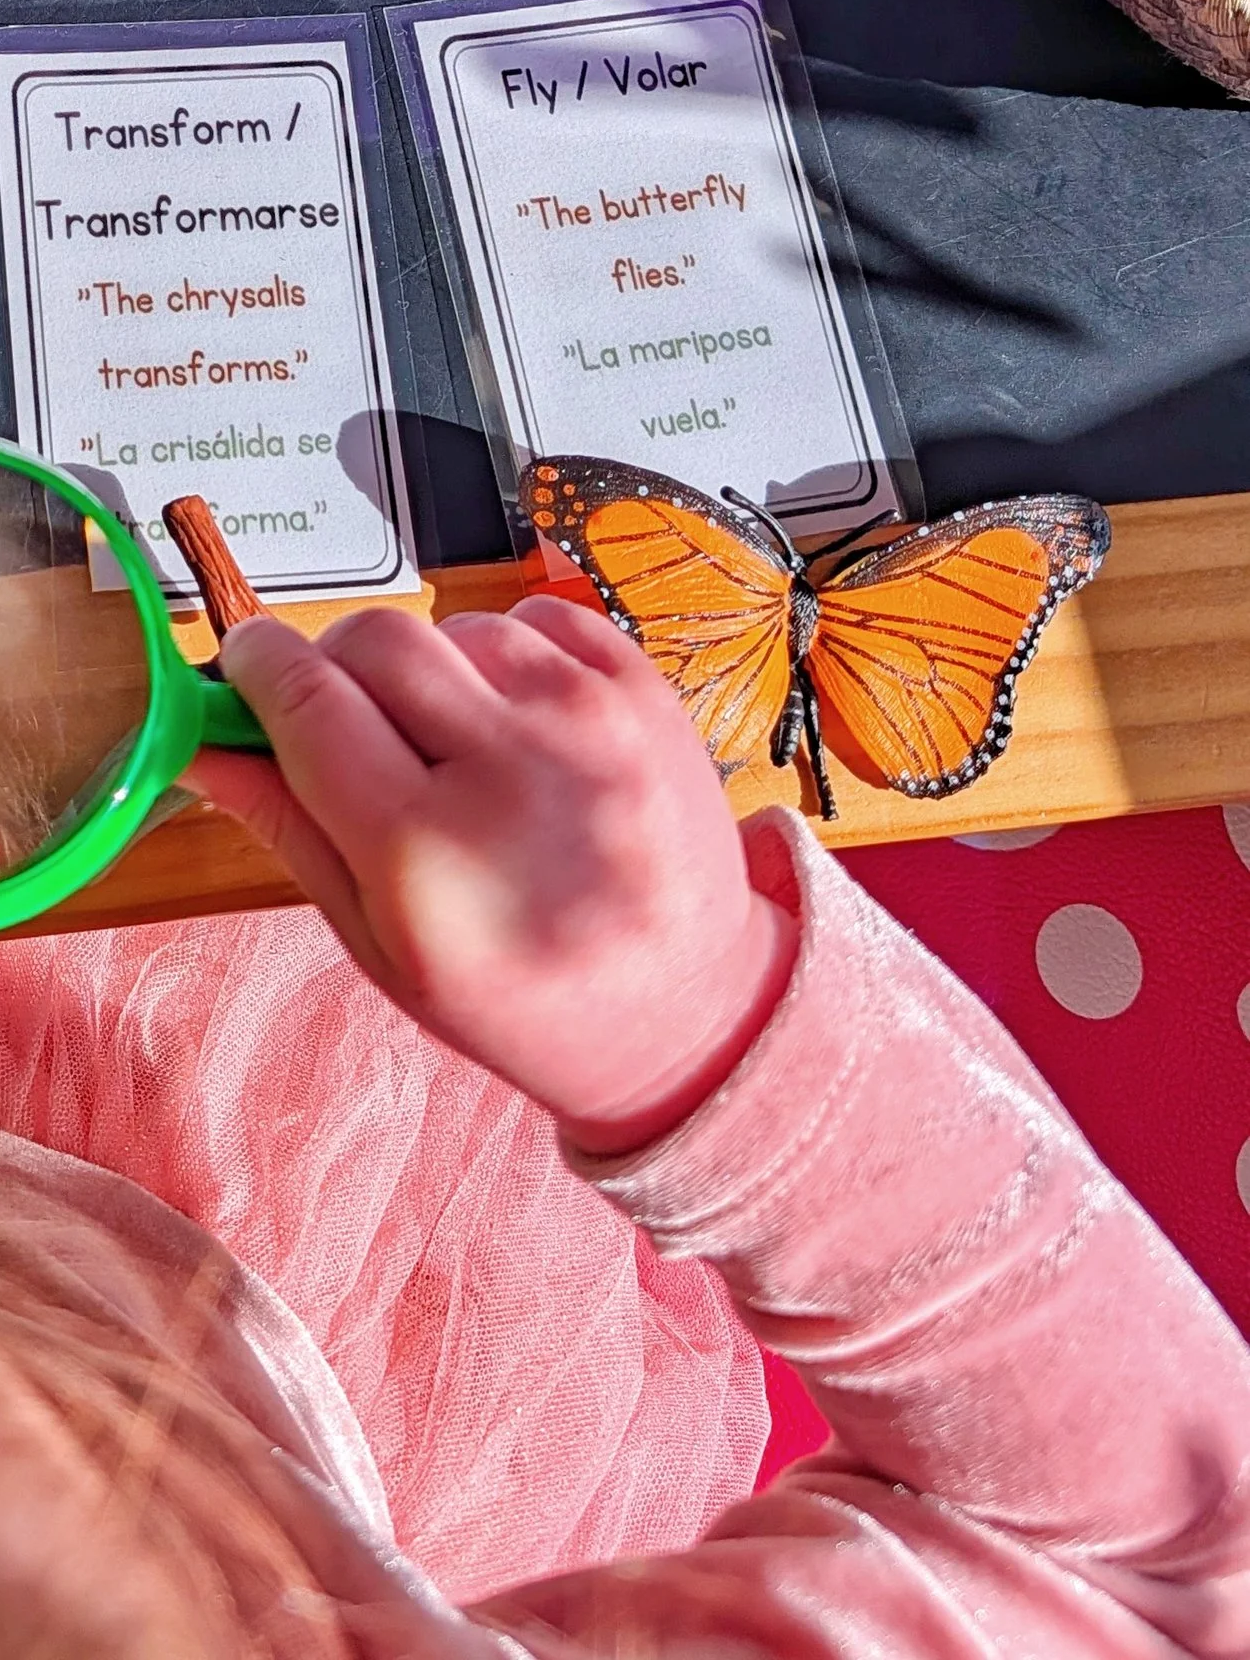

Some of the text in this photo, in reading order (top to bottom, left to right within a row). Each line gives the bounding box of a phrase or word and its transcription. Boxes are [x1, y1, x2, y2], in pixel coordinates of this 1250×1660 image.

[501, 51, 707, 114] Fly / Volar
[54, 102, 302, 151] Transform /
[35, 194, 340, 240] Transformarse
[600, 174, 745, 223] butterfly
[611, 255, 696, 293] flies.”
[167, 275, 306, 317] chrysalis
[630, 324, 773, 366] mariposa
[98, 349, 308, 391] transforms.”
[641, 398, 736, 439] vuela.”
[151, 424, 285, 464] crisálida
[298, 433, 332, 457] se
